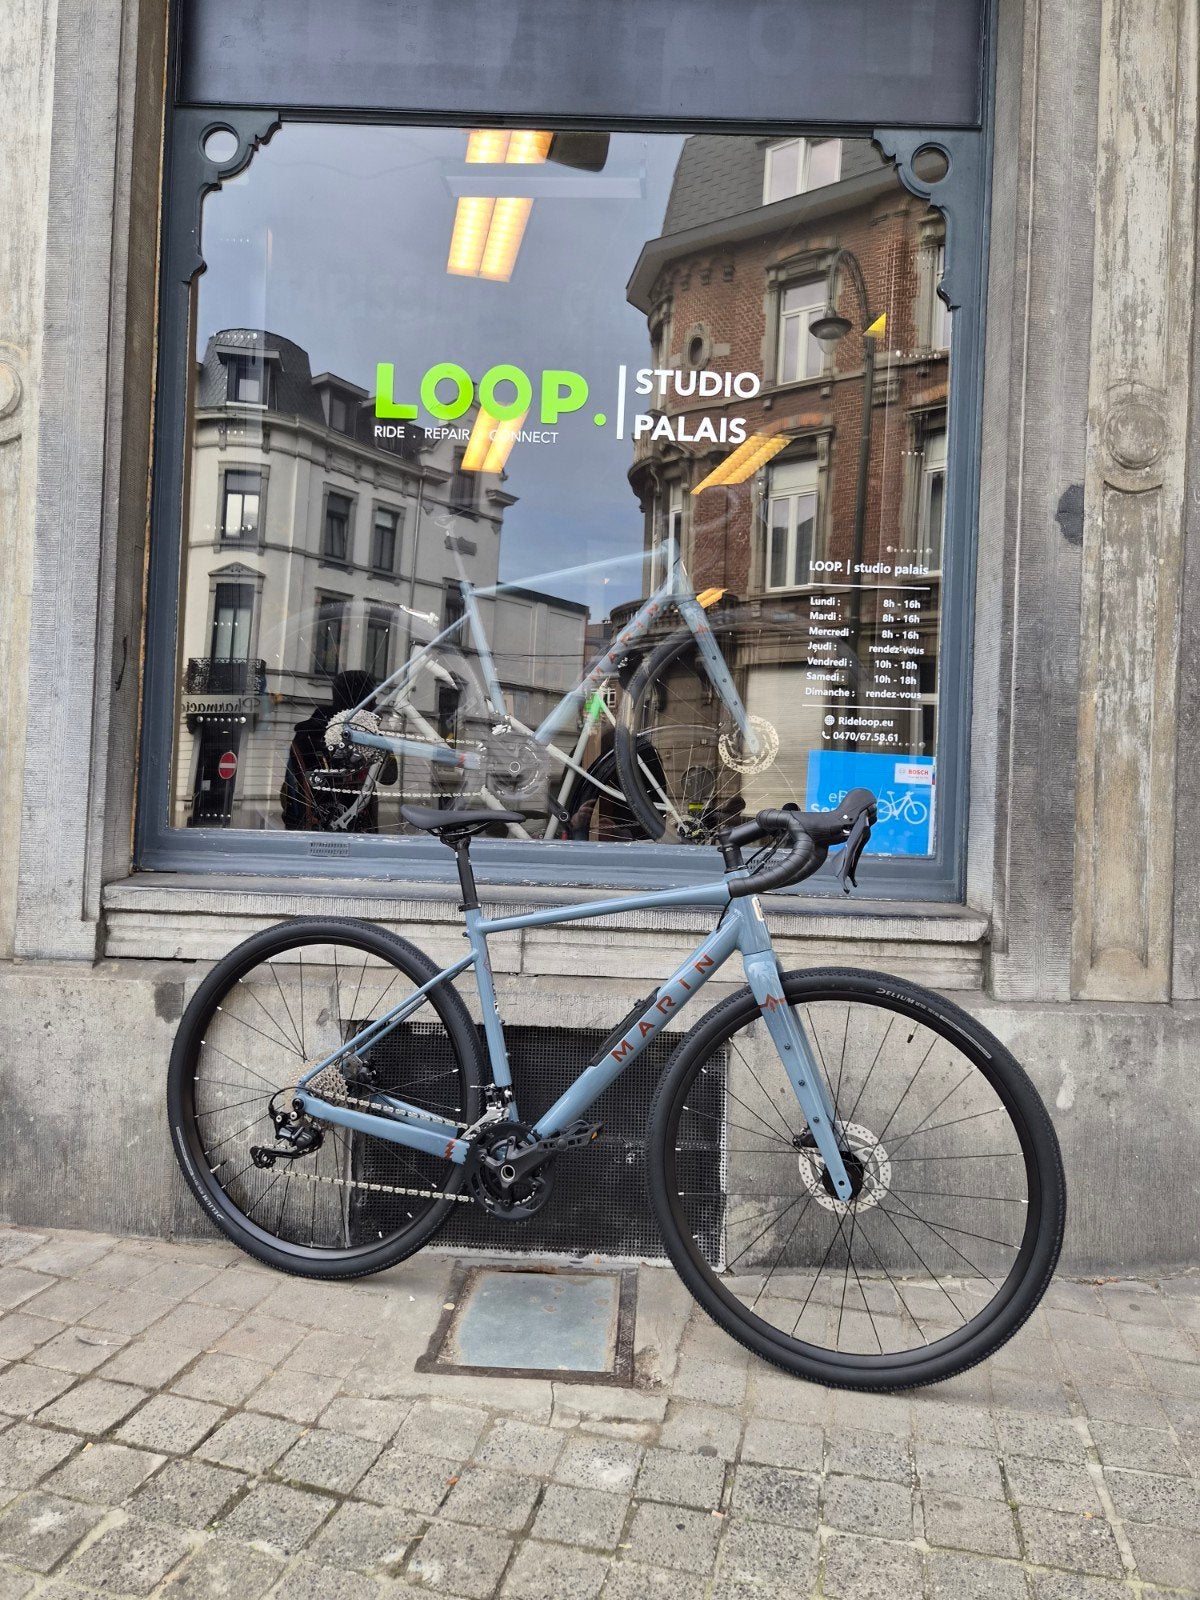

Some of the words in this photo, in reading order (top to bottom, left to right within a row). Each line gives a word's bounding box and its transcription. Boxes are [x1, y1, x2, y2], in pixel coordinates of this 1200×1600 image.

[635, 368, 760, 399] STUDIO
[375, 362, 607, 427] LOOP.
[374, 425, 405, 438] RIDE
[424, 427, 470, 440] REPAIR
[634, 414, 747, 444] PALAIS
[809, 560, 843, 572] LOOP.
[853, 563, 891, 574] studio
[894, 564, 929, 577] palais
[810, 597, 835, 606] Lundi
[883, 599, 895, 608] 8h
[904, 600, 921, 609] 16h
[809, 611, 837, 621] Mardi
[882, 614, 894, 623] 8h
[903, 615, 920, 624] 16h
[808, 627, 849, 637] Mercredi
[881, 630, 894, 639] 8h
[902, 631, 919, 640] 16h
[807, 641, 832, 651] Jeudi
[868, 645, 925, 655] rendez-vous
[807, 657, 847, 667] Vendredi
[874, 660, 892, 669] 10h
[900, 661, 918, 670] 18h
[806, 672, 840, 682] Samedi
[874, 675, 891, 684] 10h
[900, 676, 917, 685] 18h
[805, 687, 850, 697] Dimanche
[865, 690, 922, 699] rendez-vous
[838, 717, 894, 728] Rideloop.eu
[833, 731, 899, 742] 0470/67.58.61
[610, 954, 715, 1063] MARIN
